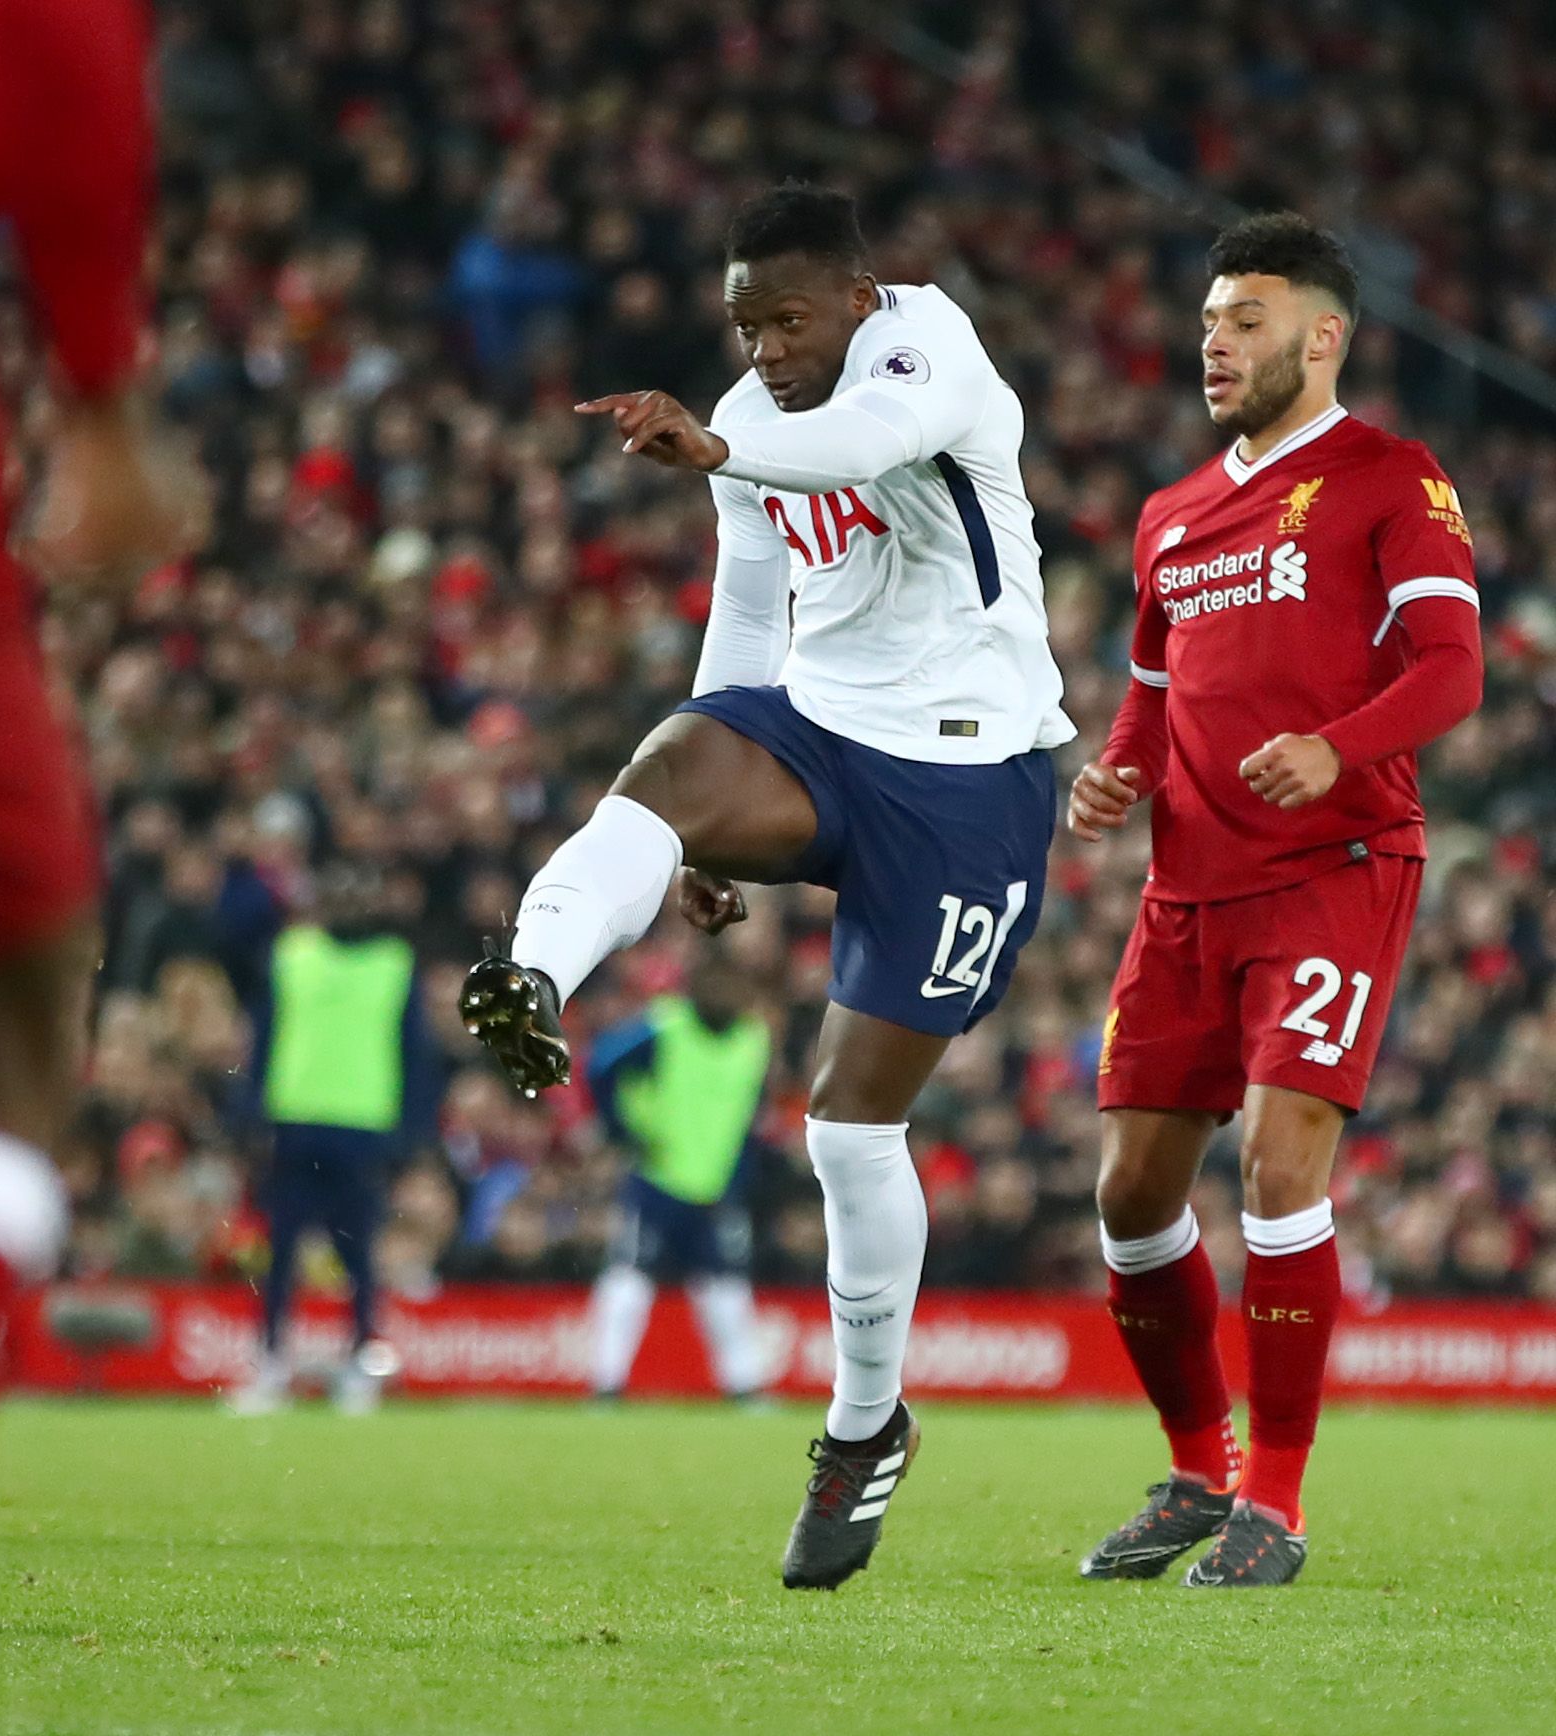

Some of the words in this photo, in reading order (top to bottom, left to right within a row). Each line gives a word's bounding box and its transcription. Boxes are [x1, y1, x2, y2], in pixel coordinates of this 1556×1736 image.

[763, 486, 891, 567] AIA
[1157, 544, 1265, 595] Standard
[1162, 576, 1263, 626] Chartered
[931, 894, 994, 988] 12
[1280, 957, 1373, 1050] 21
